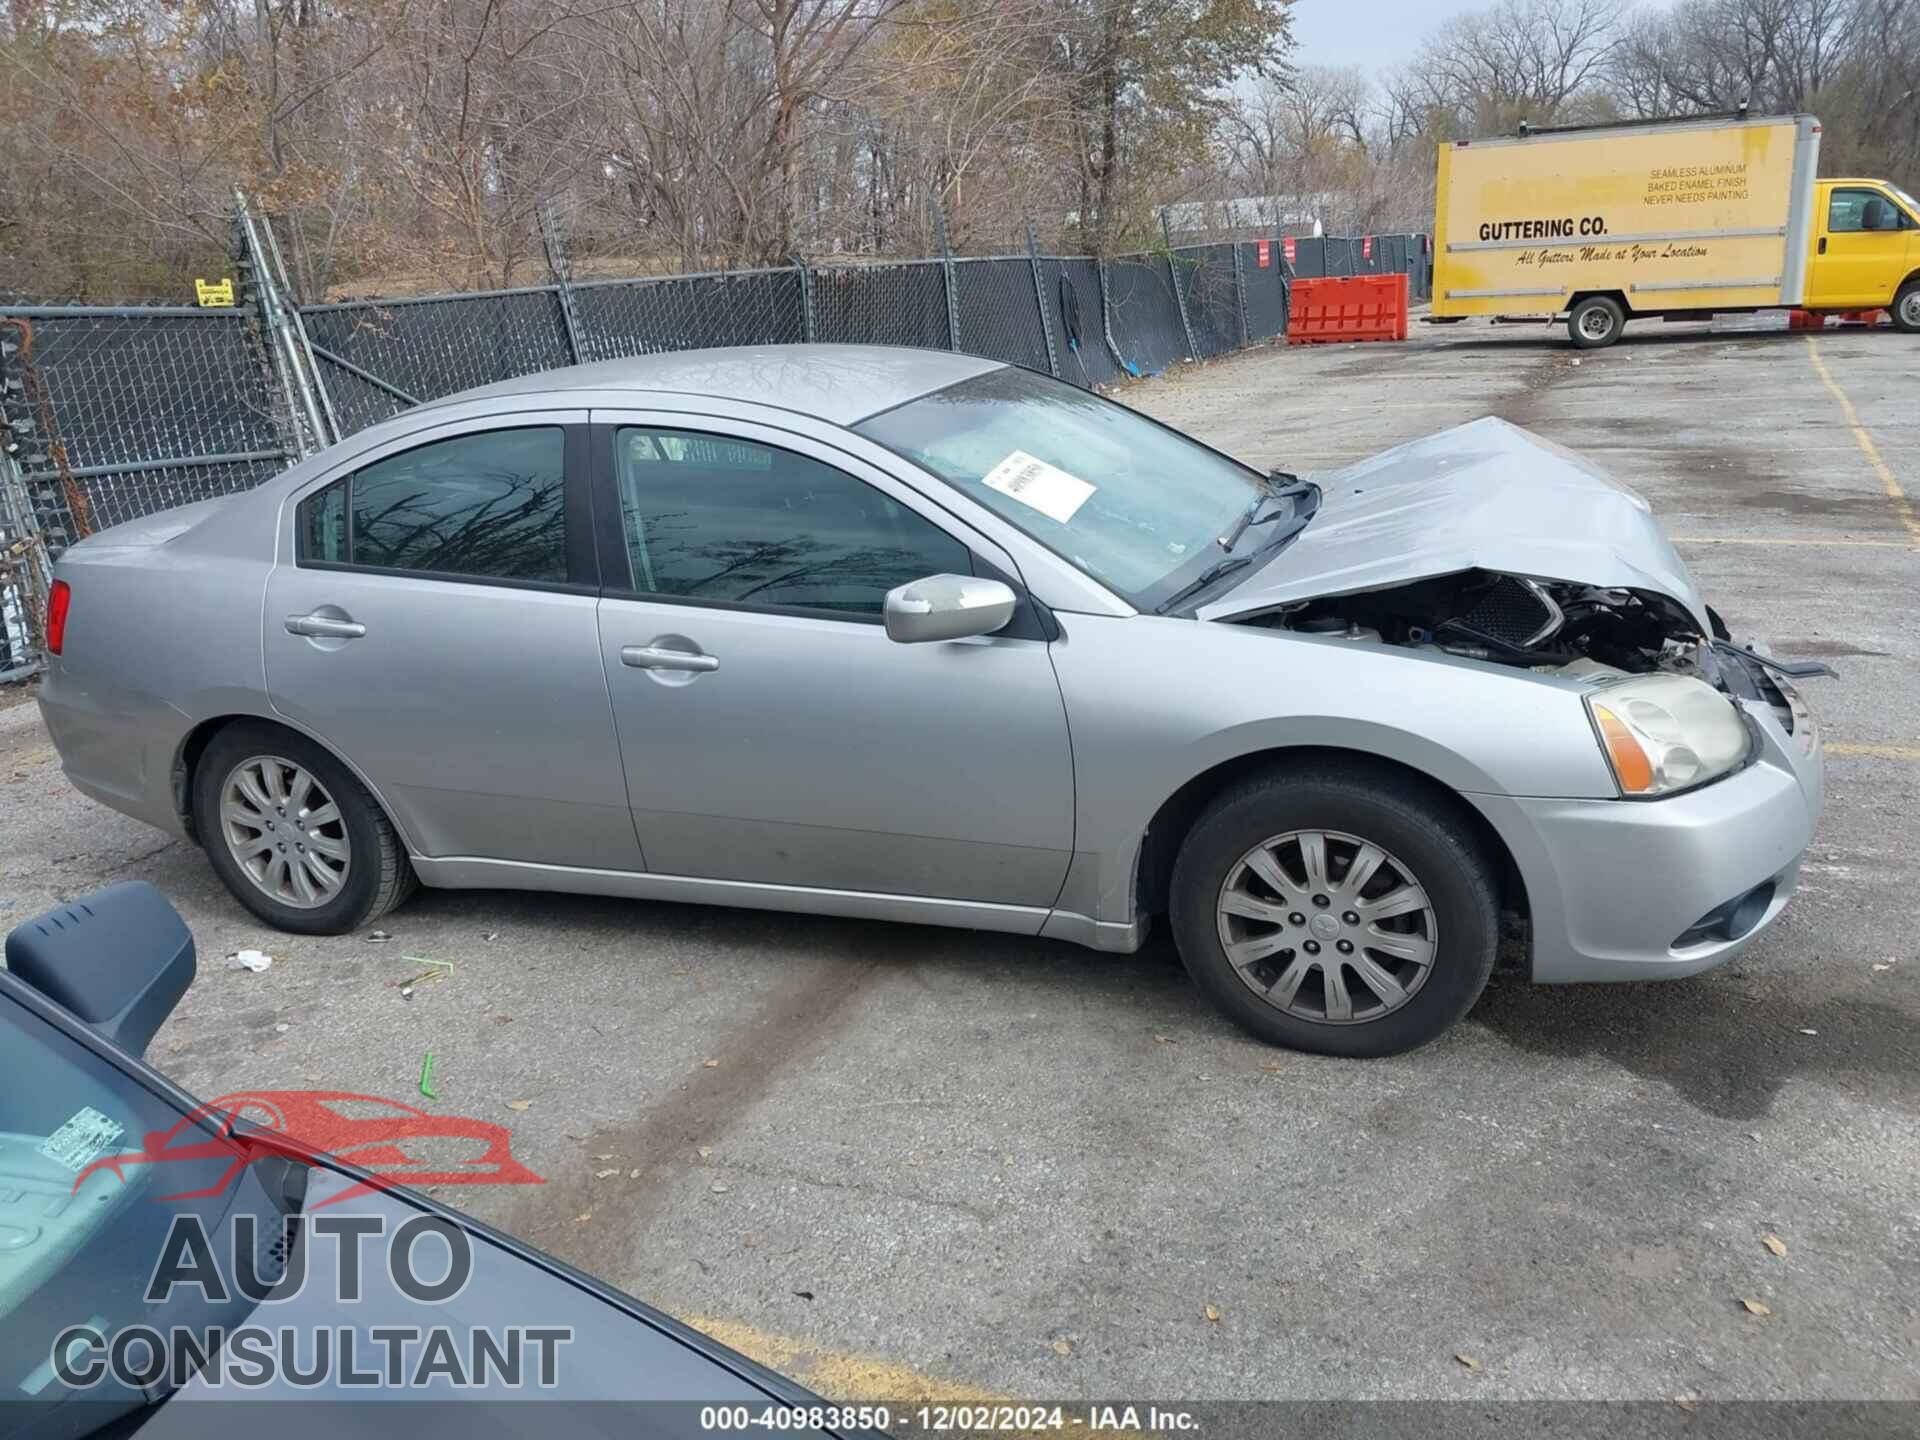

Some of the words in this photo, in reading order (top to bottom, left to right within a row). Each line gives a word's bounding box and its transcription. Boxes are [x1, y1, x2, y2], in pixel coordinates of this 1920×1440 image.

[1650, 168, 1697, 179] SEAMLESS
[1699, 164, 1747, 176] ALUMINUM
[1648, 181, 1677, 192] BAKED
[1679, 179, 1714, 190] ENAMEL
[1718, 177, 1746, 188] FINISH
[1643, 195, 1673, 205] NEVER
[1675, 193, 1705, 203] NEEDS
[1707, 190, 1749, 201] PAINTING
[1479, 218, 1574, 241] GUTTERING
[1579, 216, 1608, 236] CO.
[1516, 250, 1535, 265] All
[1538, 249, 1574, 268] Gutters
[1580, 247, 1611, 261] Made
[1615, 249, 1628, 260] at
[1631, 244, 1657, 263] Your
[1661, 243, 1708, 258] Location
